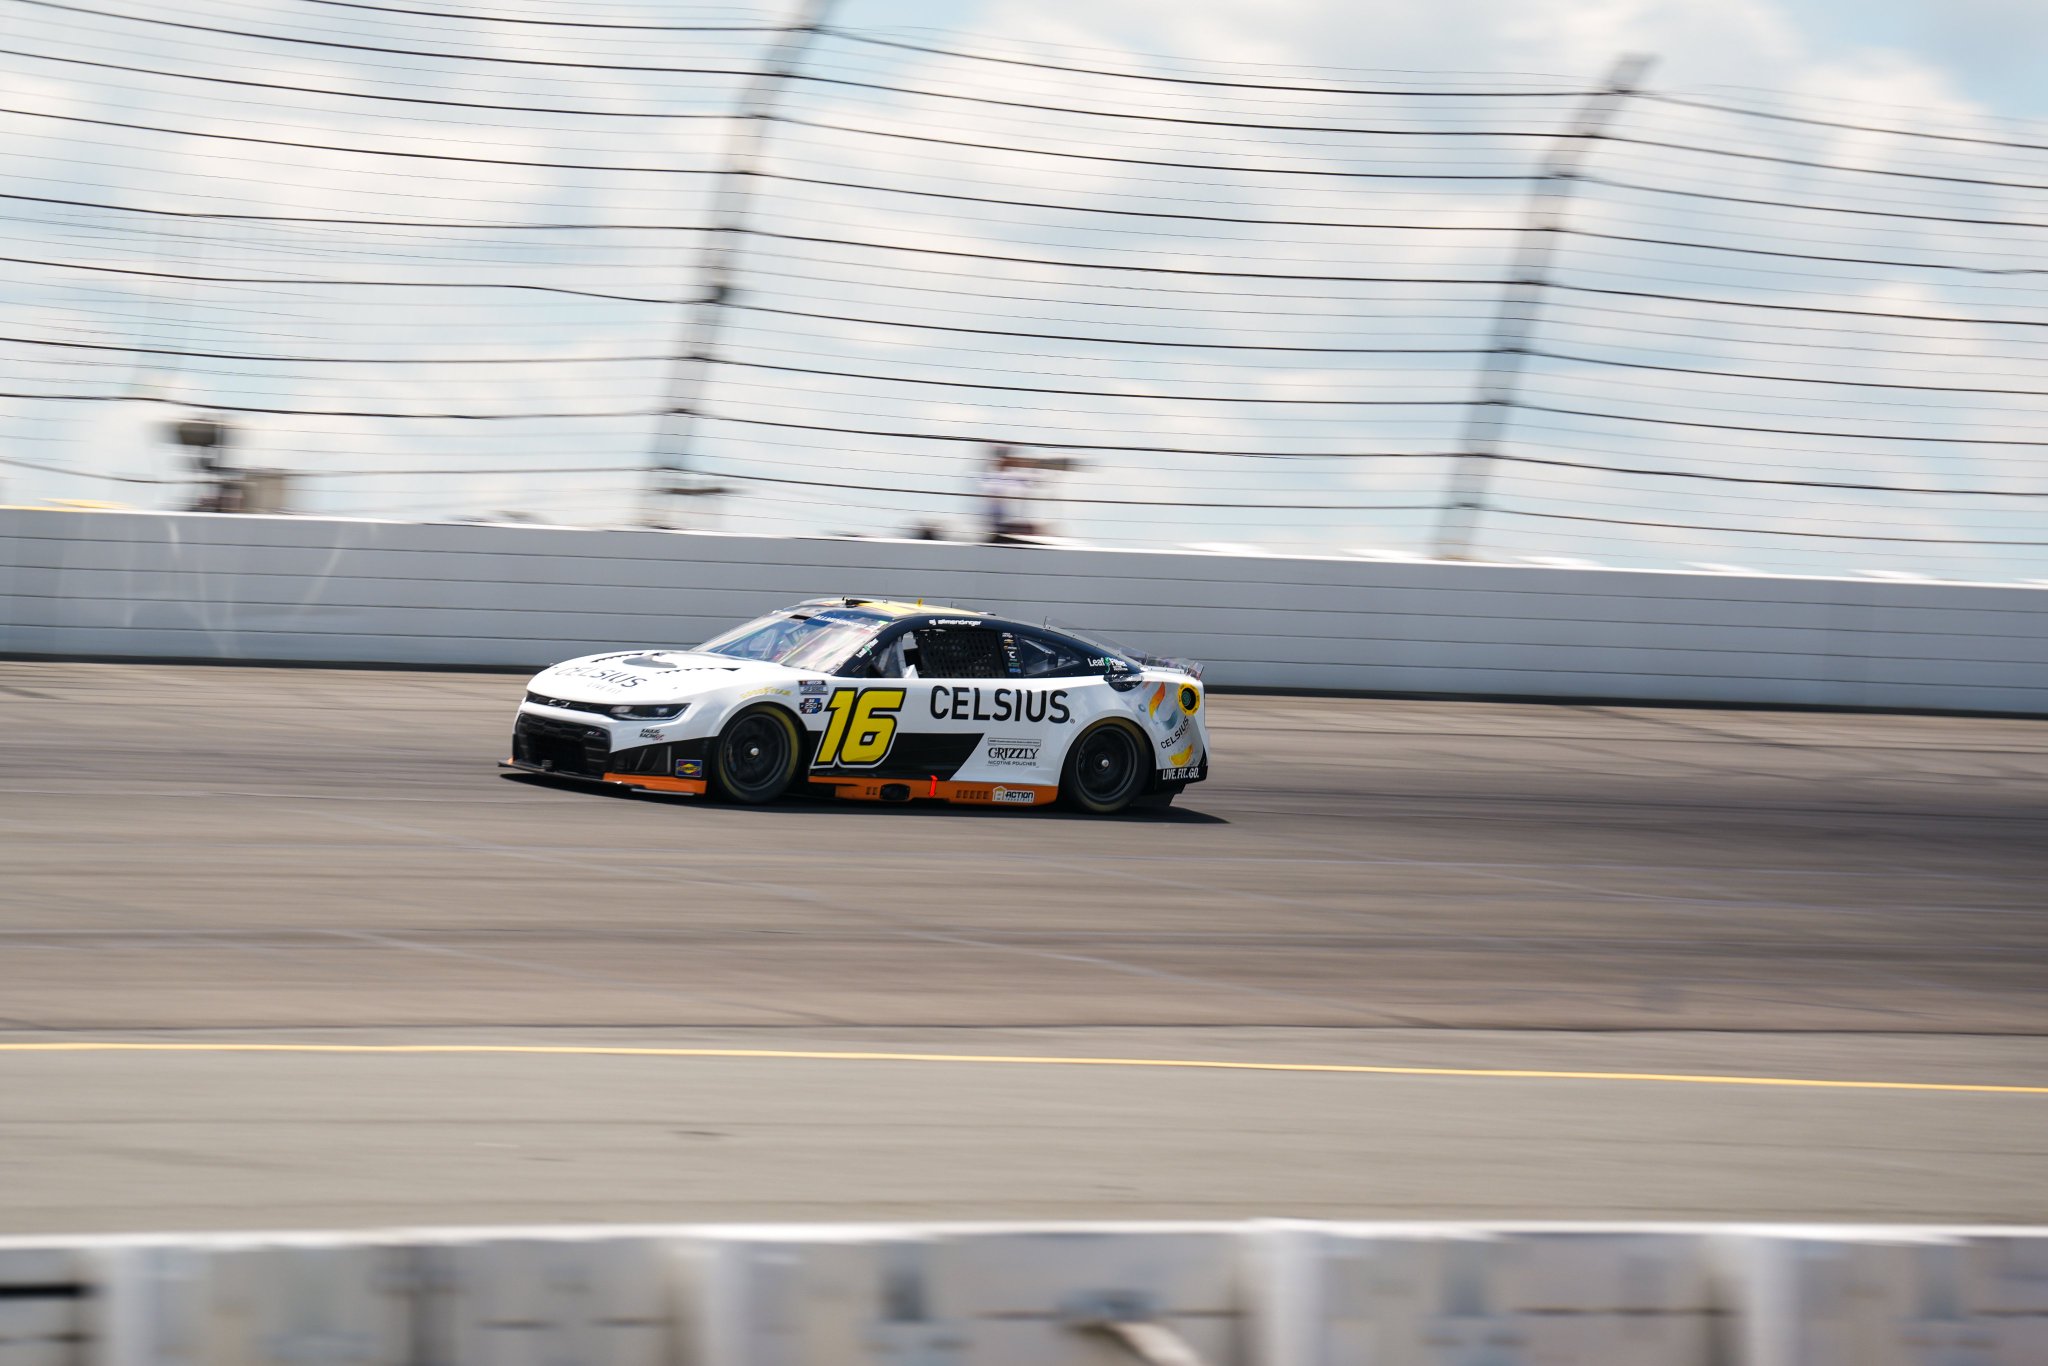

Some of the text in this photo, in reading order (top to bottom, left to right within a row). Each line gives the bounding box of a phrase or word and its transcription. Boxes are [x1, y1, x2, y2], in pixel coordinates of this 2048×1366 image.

[554, 666, 648, 688] CELSIUS
[930, 685, 1070, 724] CELSIUS
[814, 687, 907, 767] 16
[1160, 715, 1190, 749] CELSIUS
[988, 747, 1040, 760] GRIZZLY
